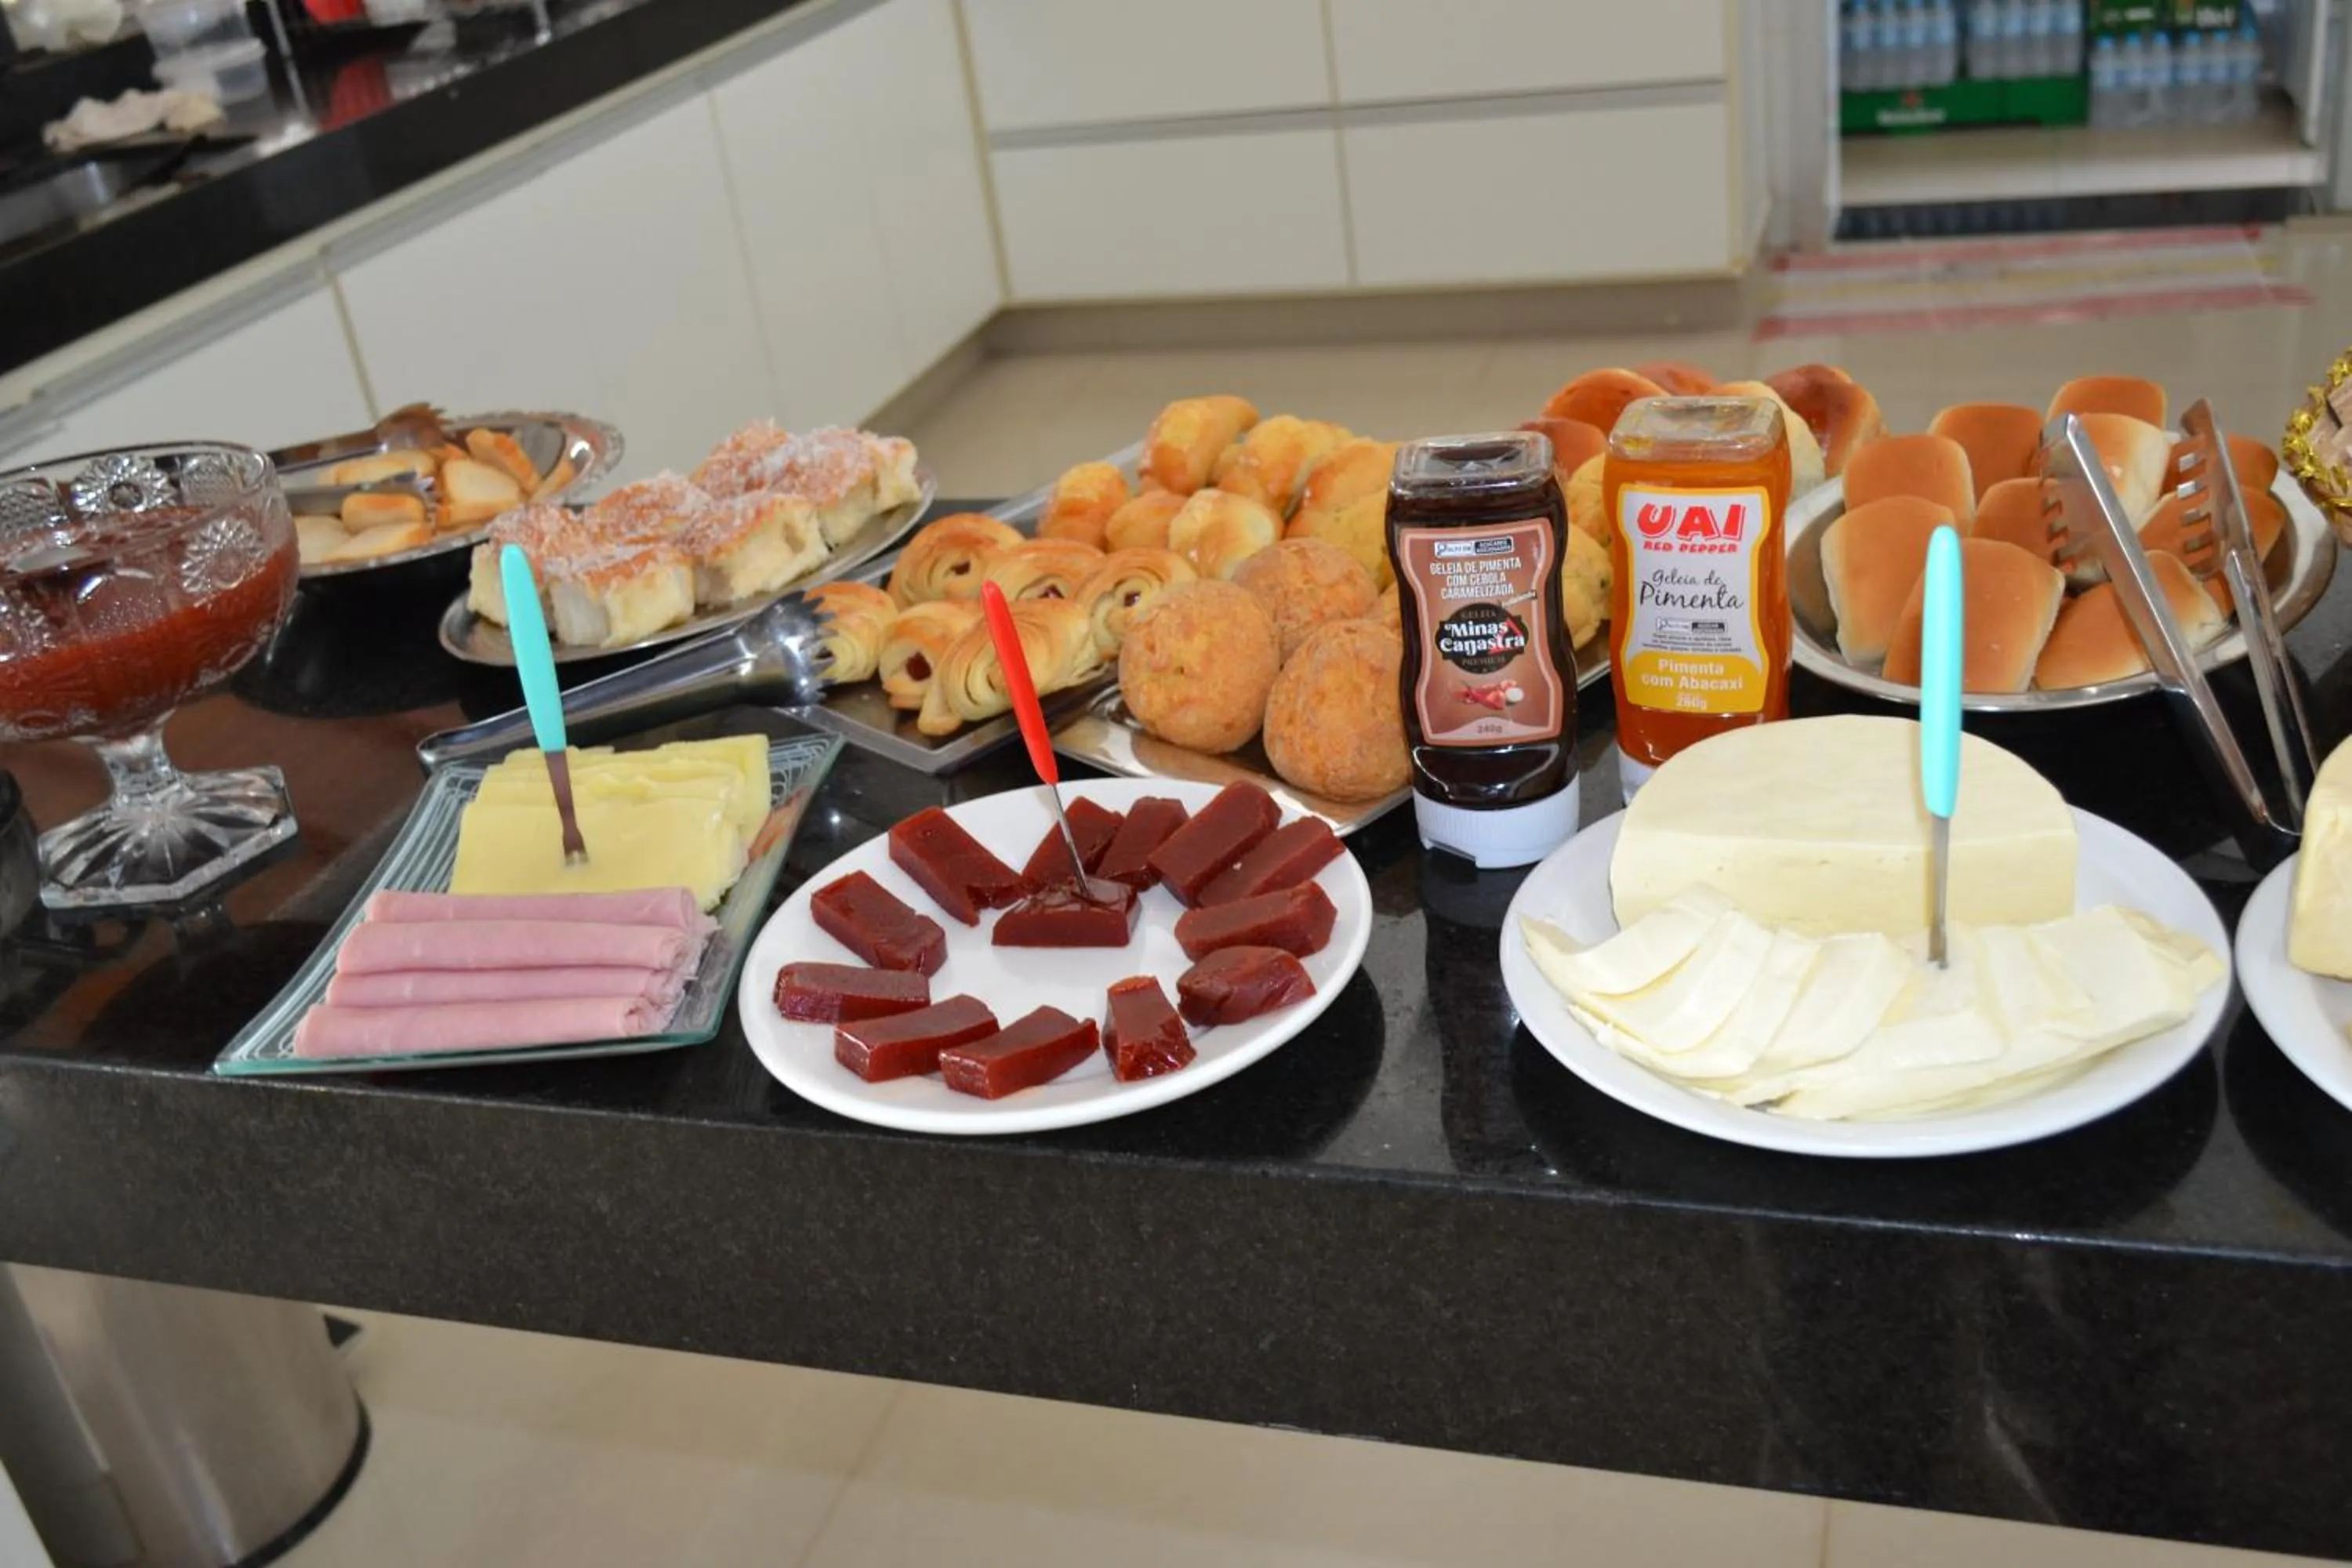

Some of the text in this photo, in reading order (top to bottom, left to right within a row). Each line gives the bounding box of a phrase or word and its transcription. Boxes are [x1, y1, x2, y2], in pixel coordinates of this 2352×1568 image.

[1637, 503, 1746, 541] UAI
[1643, 541, 1738, 554] RED PEPPER
[1430, 557, 1522, 575] GELEIA DE PIMENTA
[1446, 572, 1507, 586] COM CEBOLA
[1704, 569, 1723, 586] de
[1441, 583, 1514, 600] CARAMELIZADA
[1639, 580, 1744, 610] Pimenta
[1444, 619, 1508, 637] Minas
[1658, 658, 1724, 675] Pimenta
[1642, 673, 1744, 691] com Abacaxi
